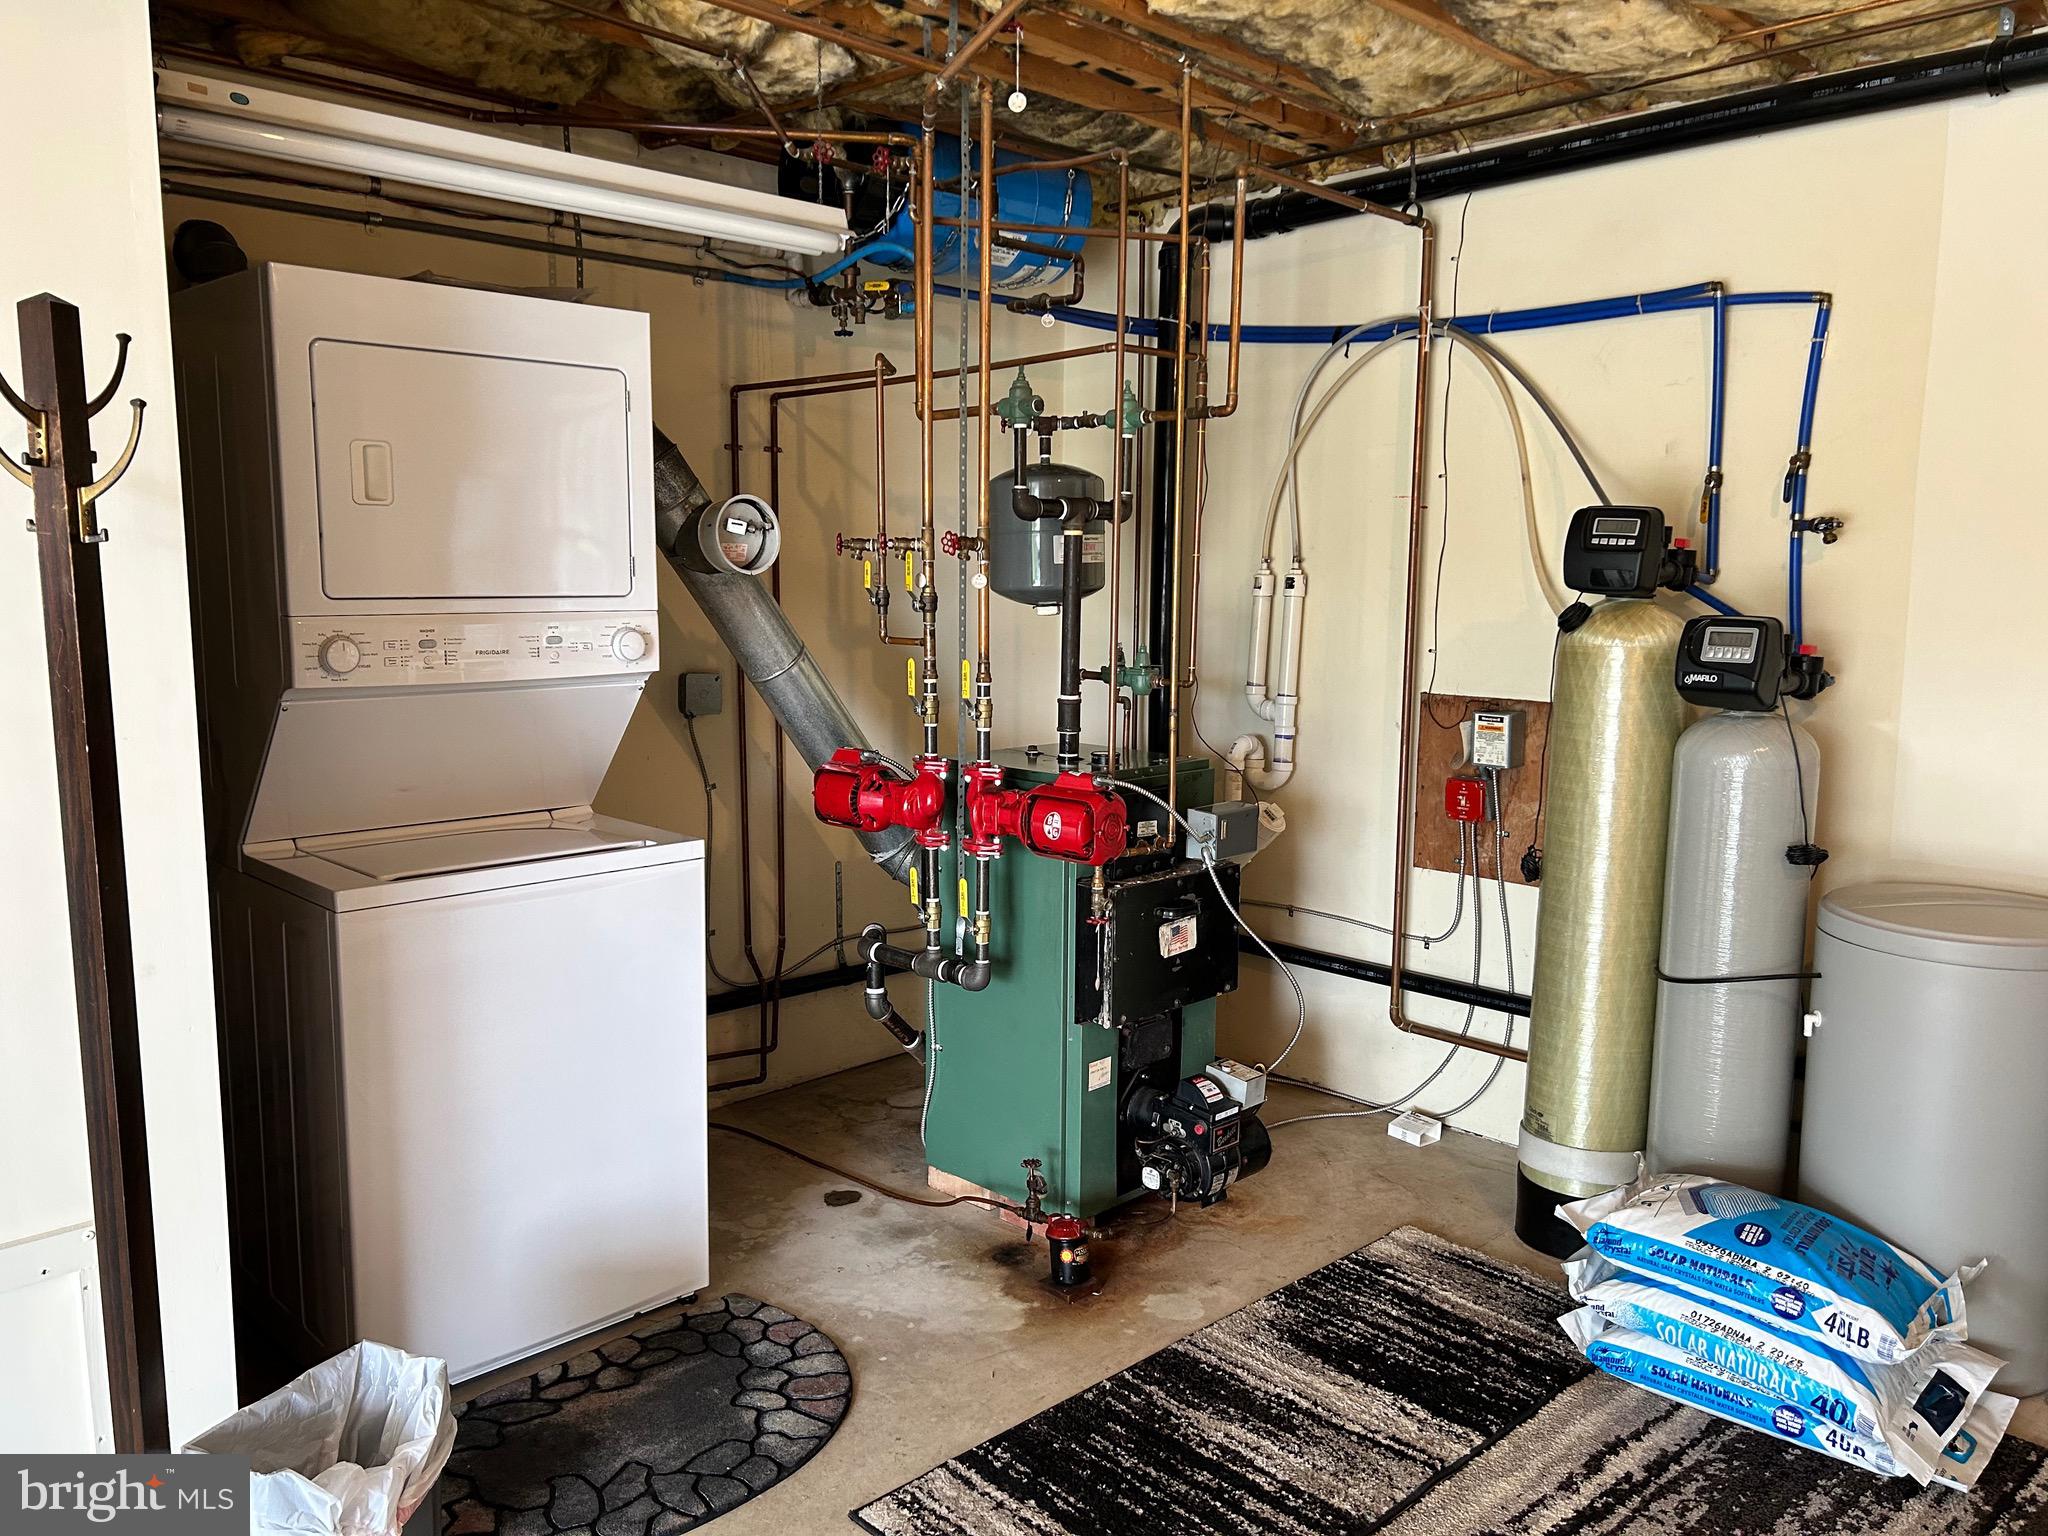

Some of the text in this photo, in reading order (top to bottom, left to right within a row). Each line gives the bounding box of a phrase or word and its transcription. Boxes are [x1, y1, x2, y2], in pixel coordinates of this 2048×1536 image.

[1690, 673, 1718, 683] MARLO
[1637, 1256, 1660, 1269] NATURAL
[1661, 1264, 1674, 1273] SALT
[1675, 1268, 1702, 1283] CRYSTALS
[1702, 1278, 1713, 1286] FOR
[1714, 1282, 1732, 1293] WATER
[1733, 1287, 1765, 1305] SOFTENERS
[1648, 1245, 1754, 1289] SOLAR NATURALS
[1656, 1321, 1801, 1401] SOLAR NATURALS
[1757, 1341, 1765, 1349] 2
[1640, 1374, 1663, 1387] NATURAL
[1663, 1380, 1676, 1391] SALT
[1677, 1385, 1704, 1400] CRYSTALS
[1704, 1396, 1716, 1406] FOR
[1716, 1400, 1735, 1412] WATER
[1735, 1405, 1767, 1424] SOFTENERS
[1651, 1365, 1689, 1386] SOLAR
[1690, 1378, 1754, 1409] NATURALS
[1810, 1394, 1848, 1425] 40
